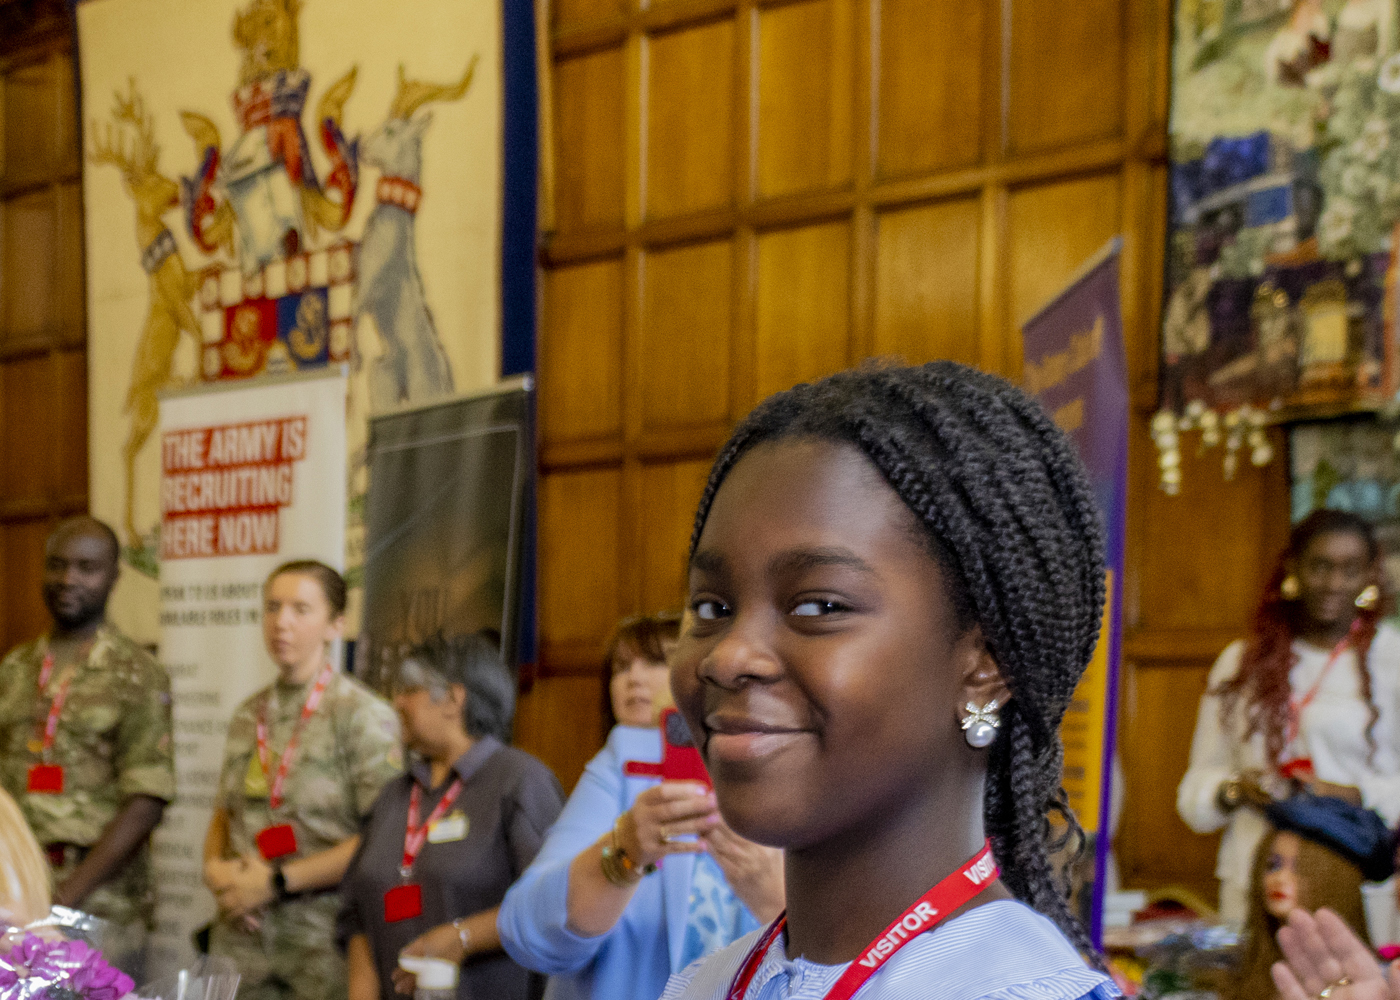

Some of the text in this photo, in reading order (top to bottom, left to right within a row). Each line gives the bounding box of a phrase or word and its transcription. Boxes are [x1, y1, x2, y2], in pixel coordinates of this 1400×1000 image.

[162, 419, 304, 469] THE ARMY IS
[163, 464, 291, 510] RECRUITING
[218, 513, 278, 552] NOW
[858, 901, 939, 968] VISITOR
